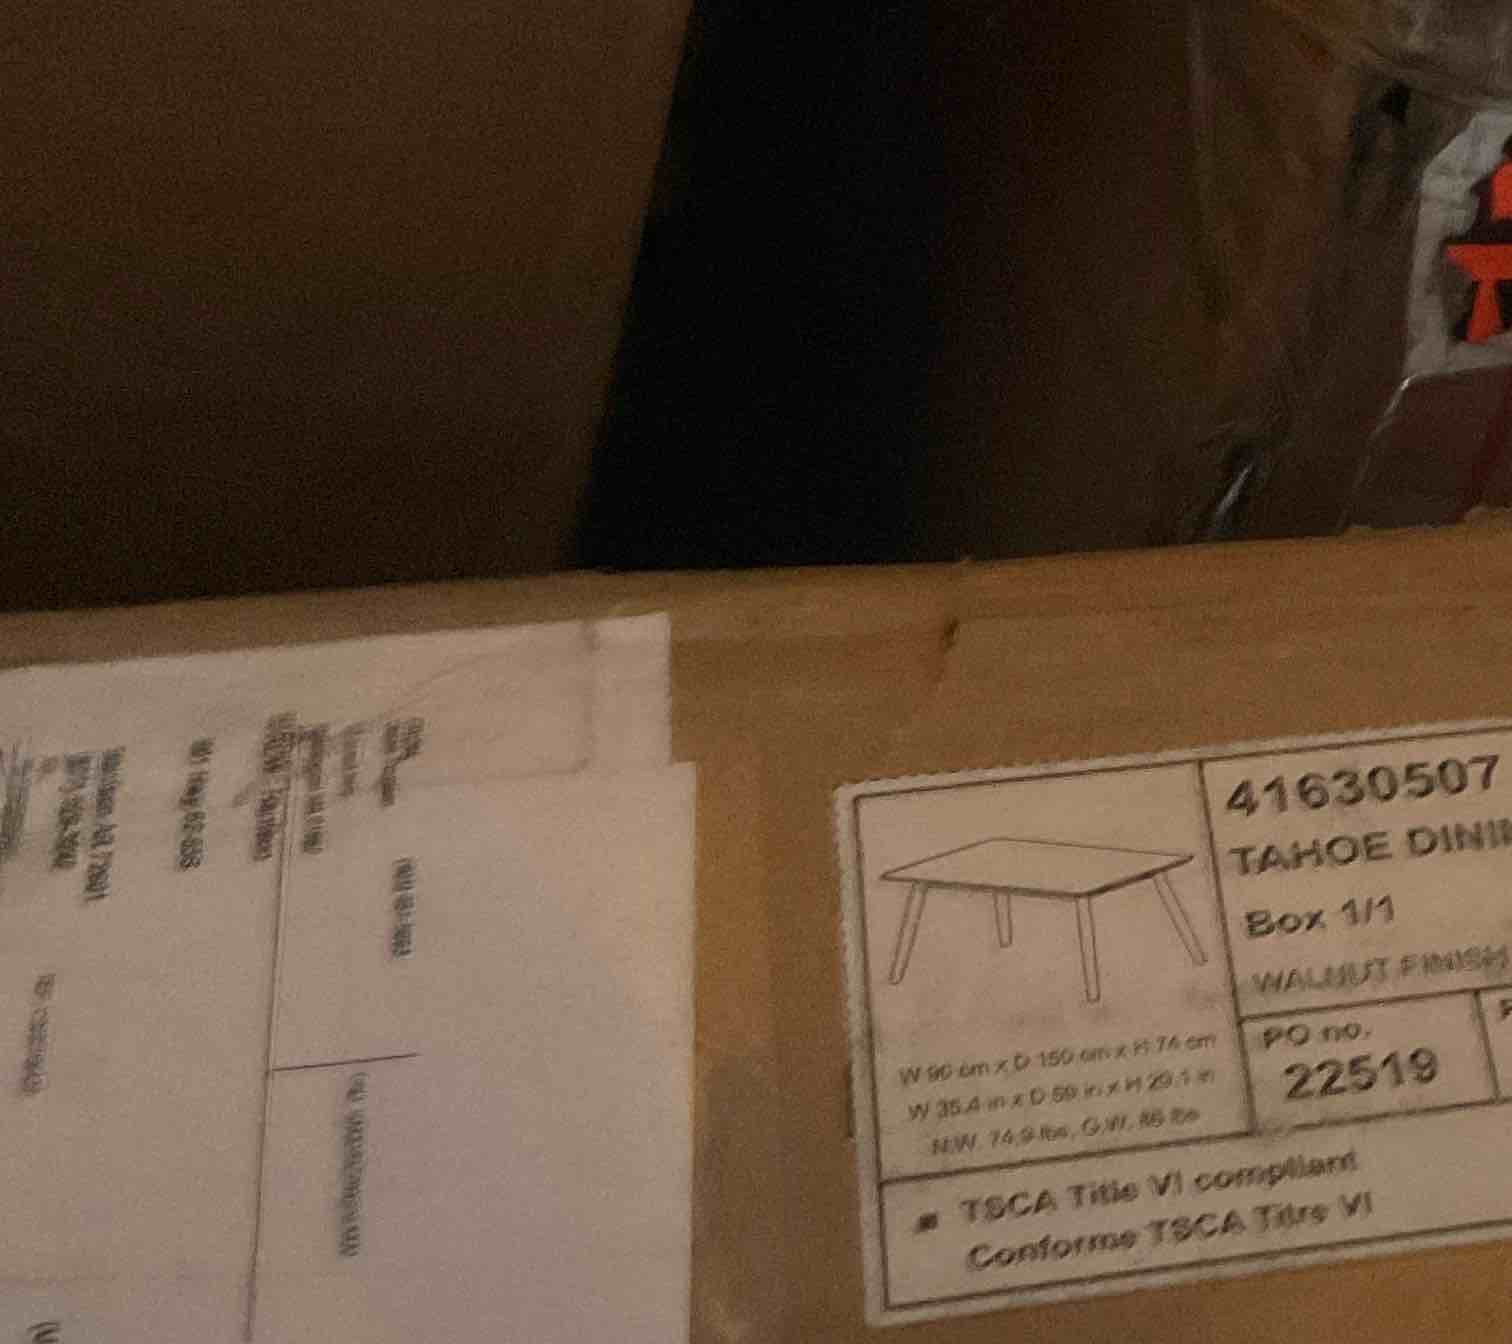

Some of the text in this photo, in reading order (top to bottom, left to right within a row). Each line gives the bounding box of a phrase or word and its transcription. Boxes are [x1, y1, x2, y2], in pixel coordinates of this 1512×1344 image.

[1225, 754, 1500, 817] 41630507
[1229, 829, 1394, 877] TAHOE
[1244, 894, 1396, 939] Box 1/1
[1251, 945, 1510, 994] WALNUT FINISH
[1262, 1022, 1372, 1050] PO no.
[900, 1064, 922, 1086] W
[1283, 1045, 1440, 1103] 22519
[908, 1102, 930, 1122] W
[958, 1148, 1359, 1225] TSCA Title VI compliant
[966, 1189, 1375, 1274] Conforme TSCA Titre VI
